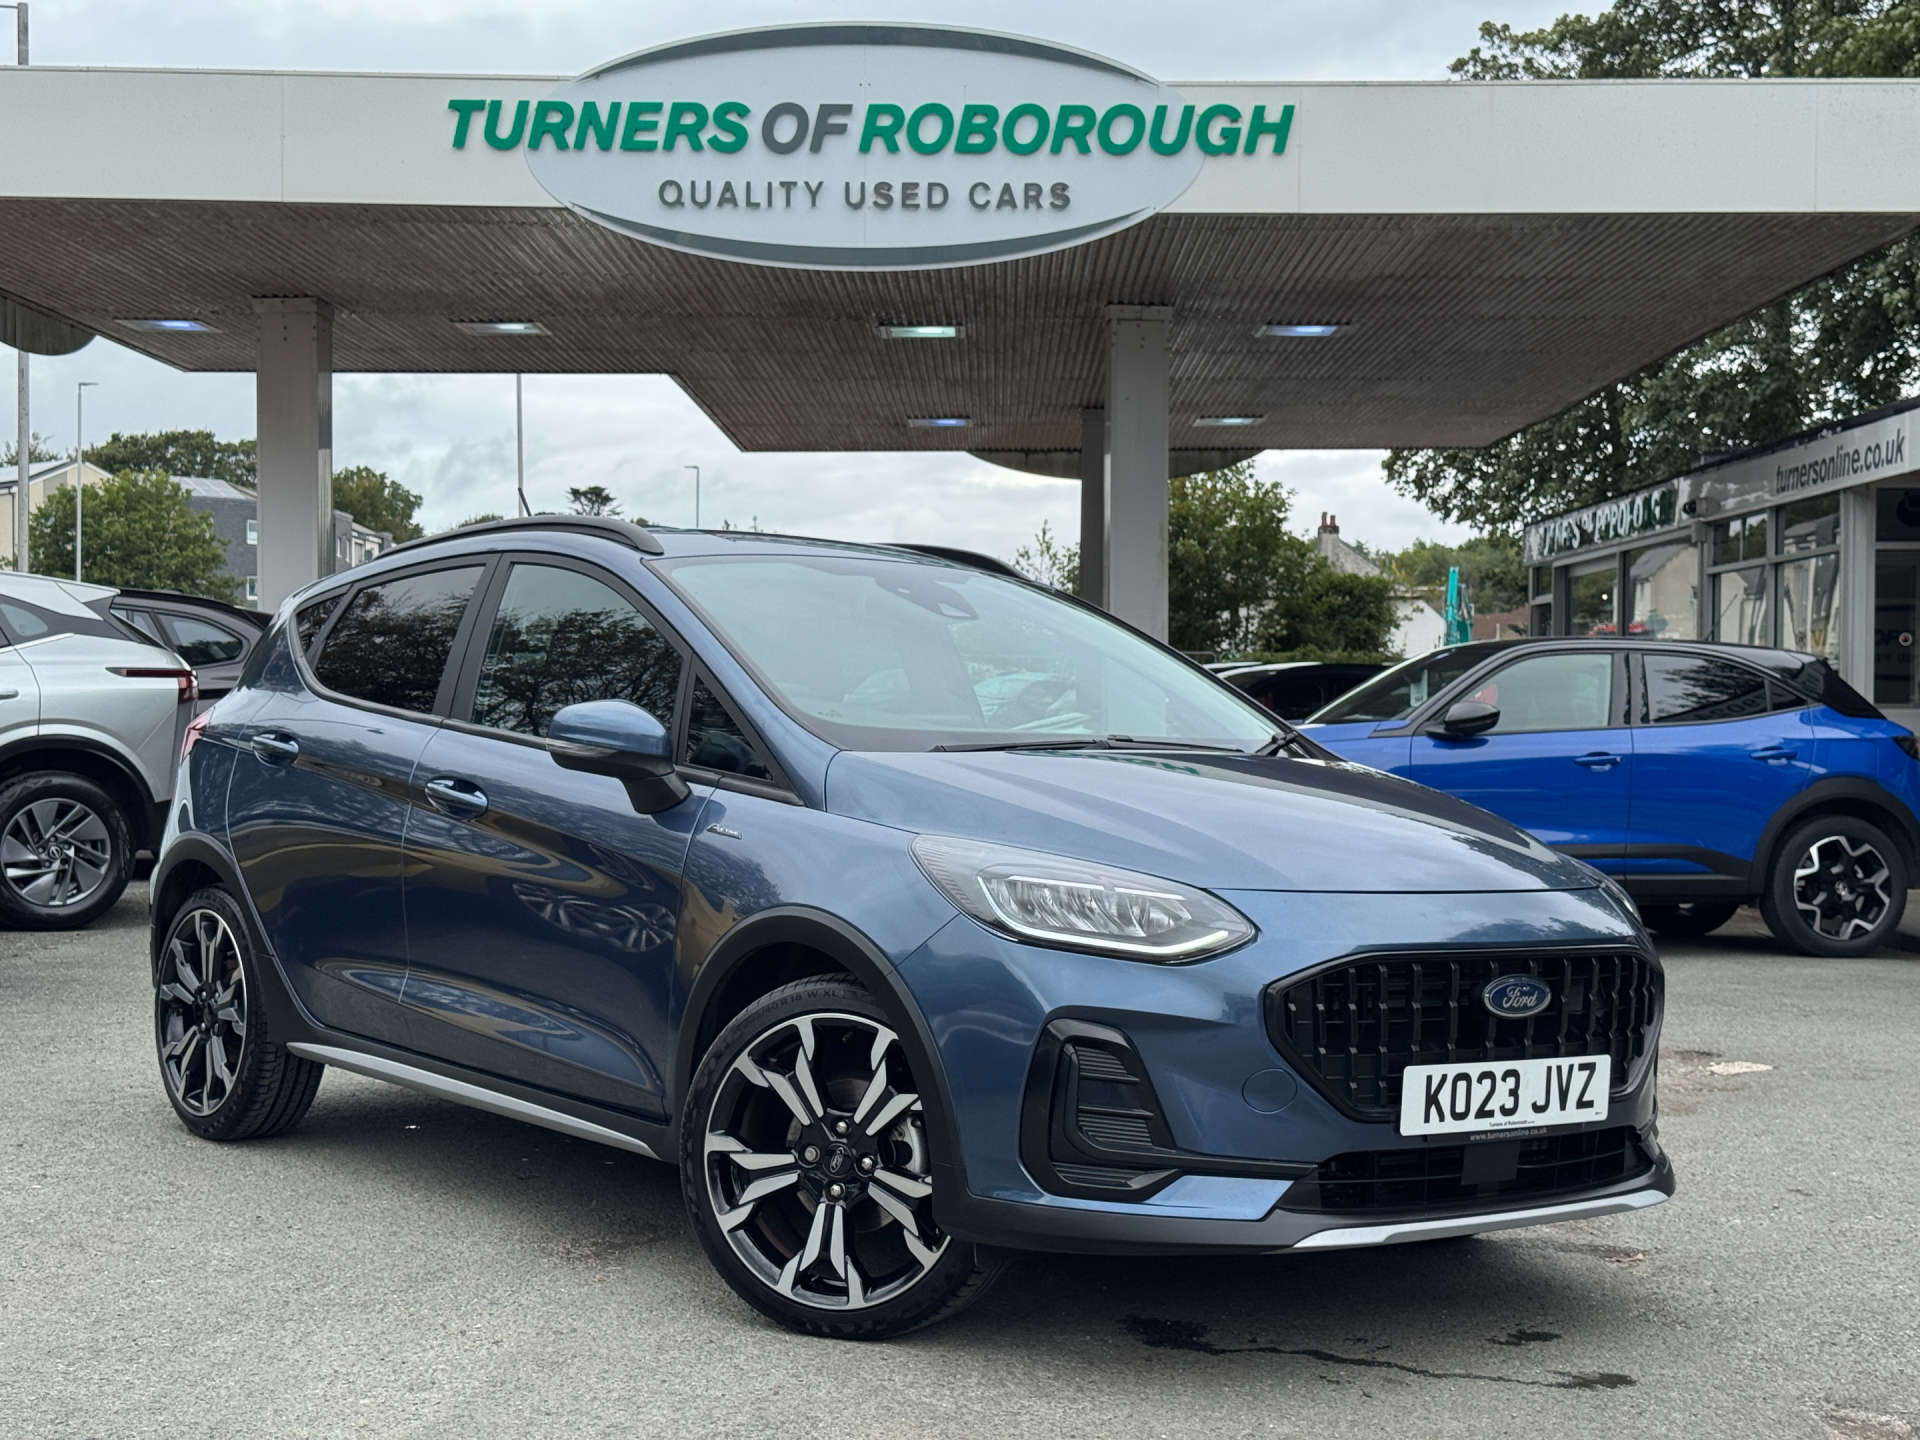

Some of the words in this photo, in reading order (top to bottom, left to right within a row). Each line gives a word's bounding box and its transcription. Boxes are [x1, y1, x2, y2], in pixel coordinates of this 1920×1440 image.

[448, 99, 751, 154] TURNERS
[761, 102, 853, 154] OF
[858, 103, 1296, 156] ROBOROUGH
[658, 179, 824, 209] QUALITY
[845, 181, 949, 210] USED
[969, 182, 1071, 210] CARS
[1776, 428, 1905, 494] turnersonline.co.uk
[1503, 986, 1537, 1008] Ford
[1424, 1067, 1521, 1124] KO23
[1531, 1061, 1597, 1114] JVZ
